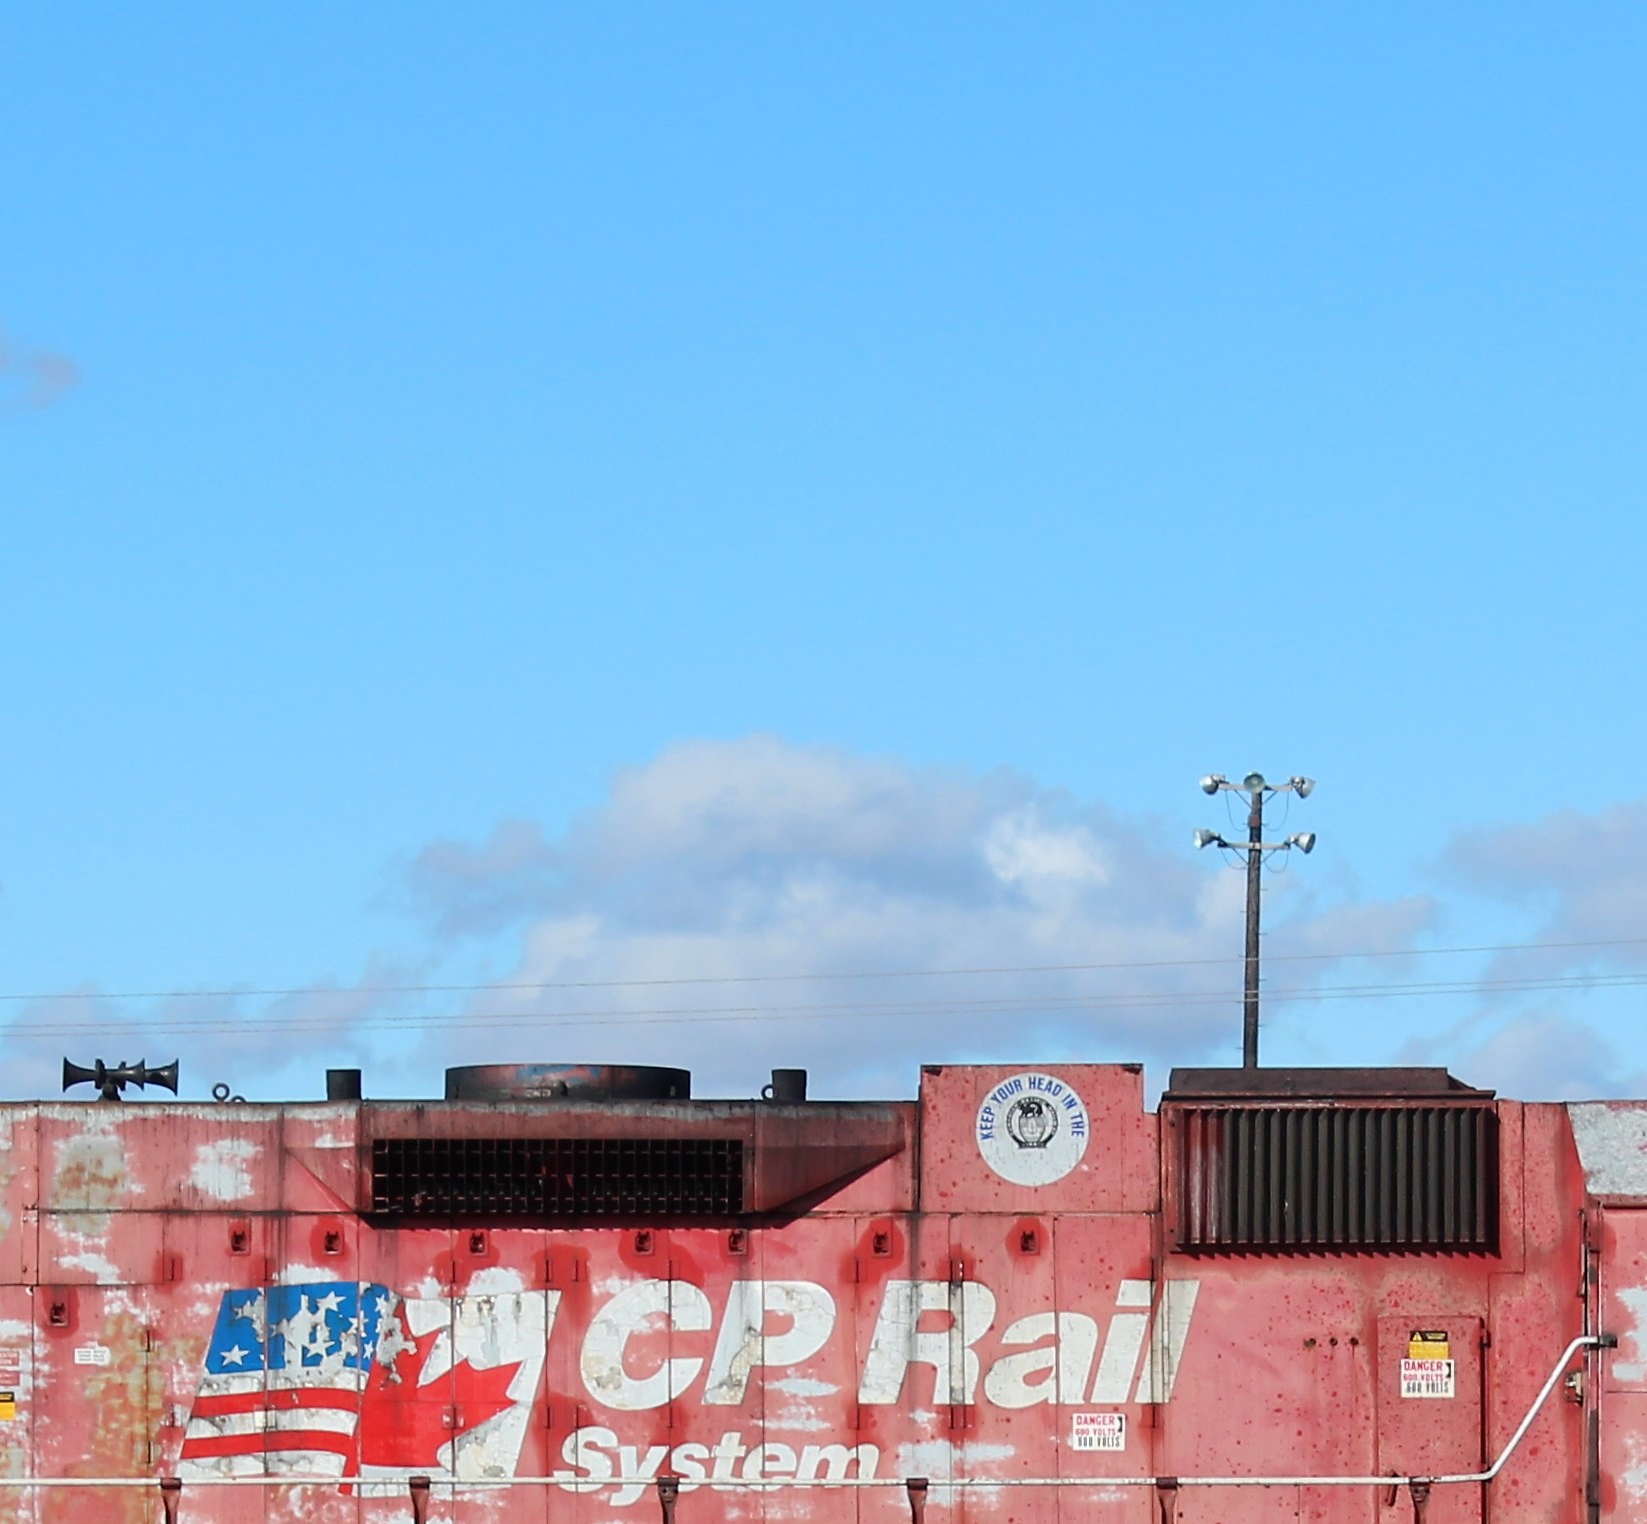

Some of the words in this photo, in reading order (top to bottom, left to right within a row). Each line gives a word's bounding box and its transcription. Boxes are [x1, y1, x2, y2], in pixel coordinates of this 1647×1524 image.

[980, 1106, 995, 1141] KEEP
[991, 1079, 1023, 1104] YOUR
[1028, 1076, 1063, 1097] HEAD
[1061, 1094, 1078, 1110] IN
[1070, 1111, 1085, 1138] THE
[580, 1278, 836, 1410] CP
[858, 1279, 1200, 1405] Rail
[1404, 1361, 1443, 1371] DANGER
[1420, 1373, 1444, 1381] VOLTS
[1426, 1381, 1449, 1393] VOLTS
[1076, 1415, 1115, 1425] DANGER
[1093, 1428, 1116, 1436] VOLTS
[1097, 1436, 1120, 1447] VOLTS
[553, 1426, 879, 1506] System
